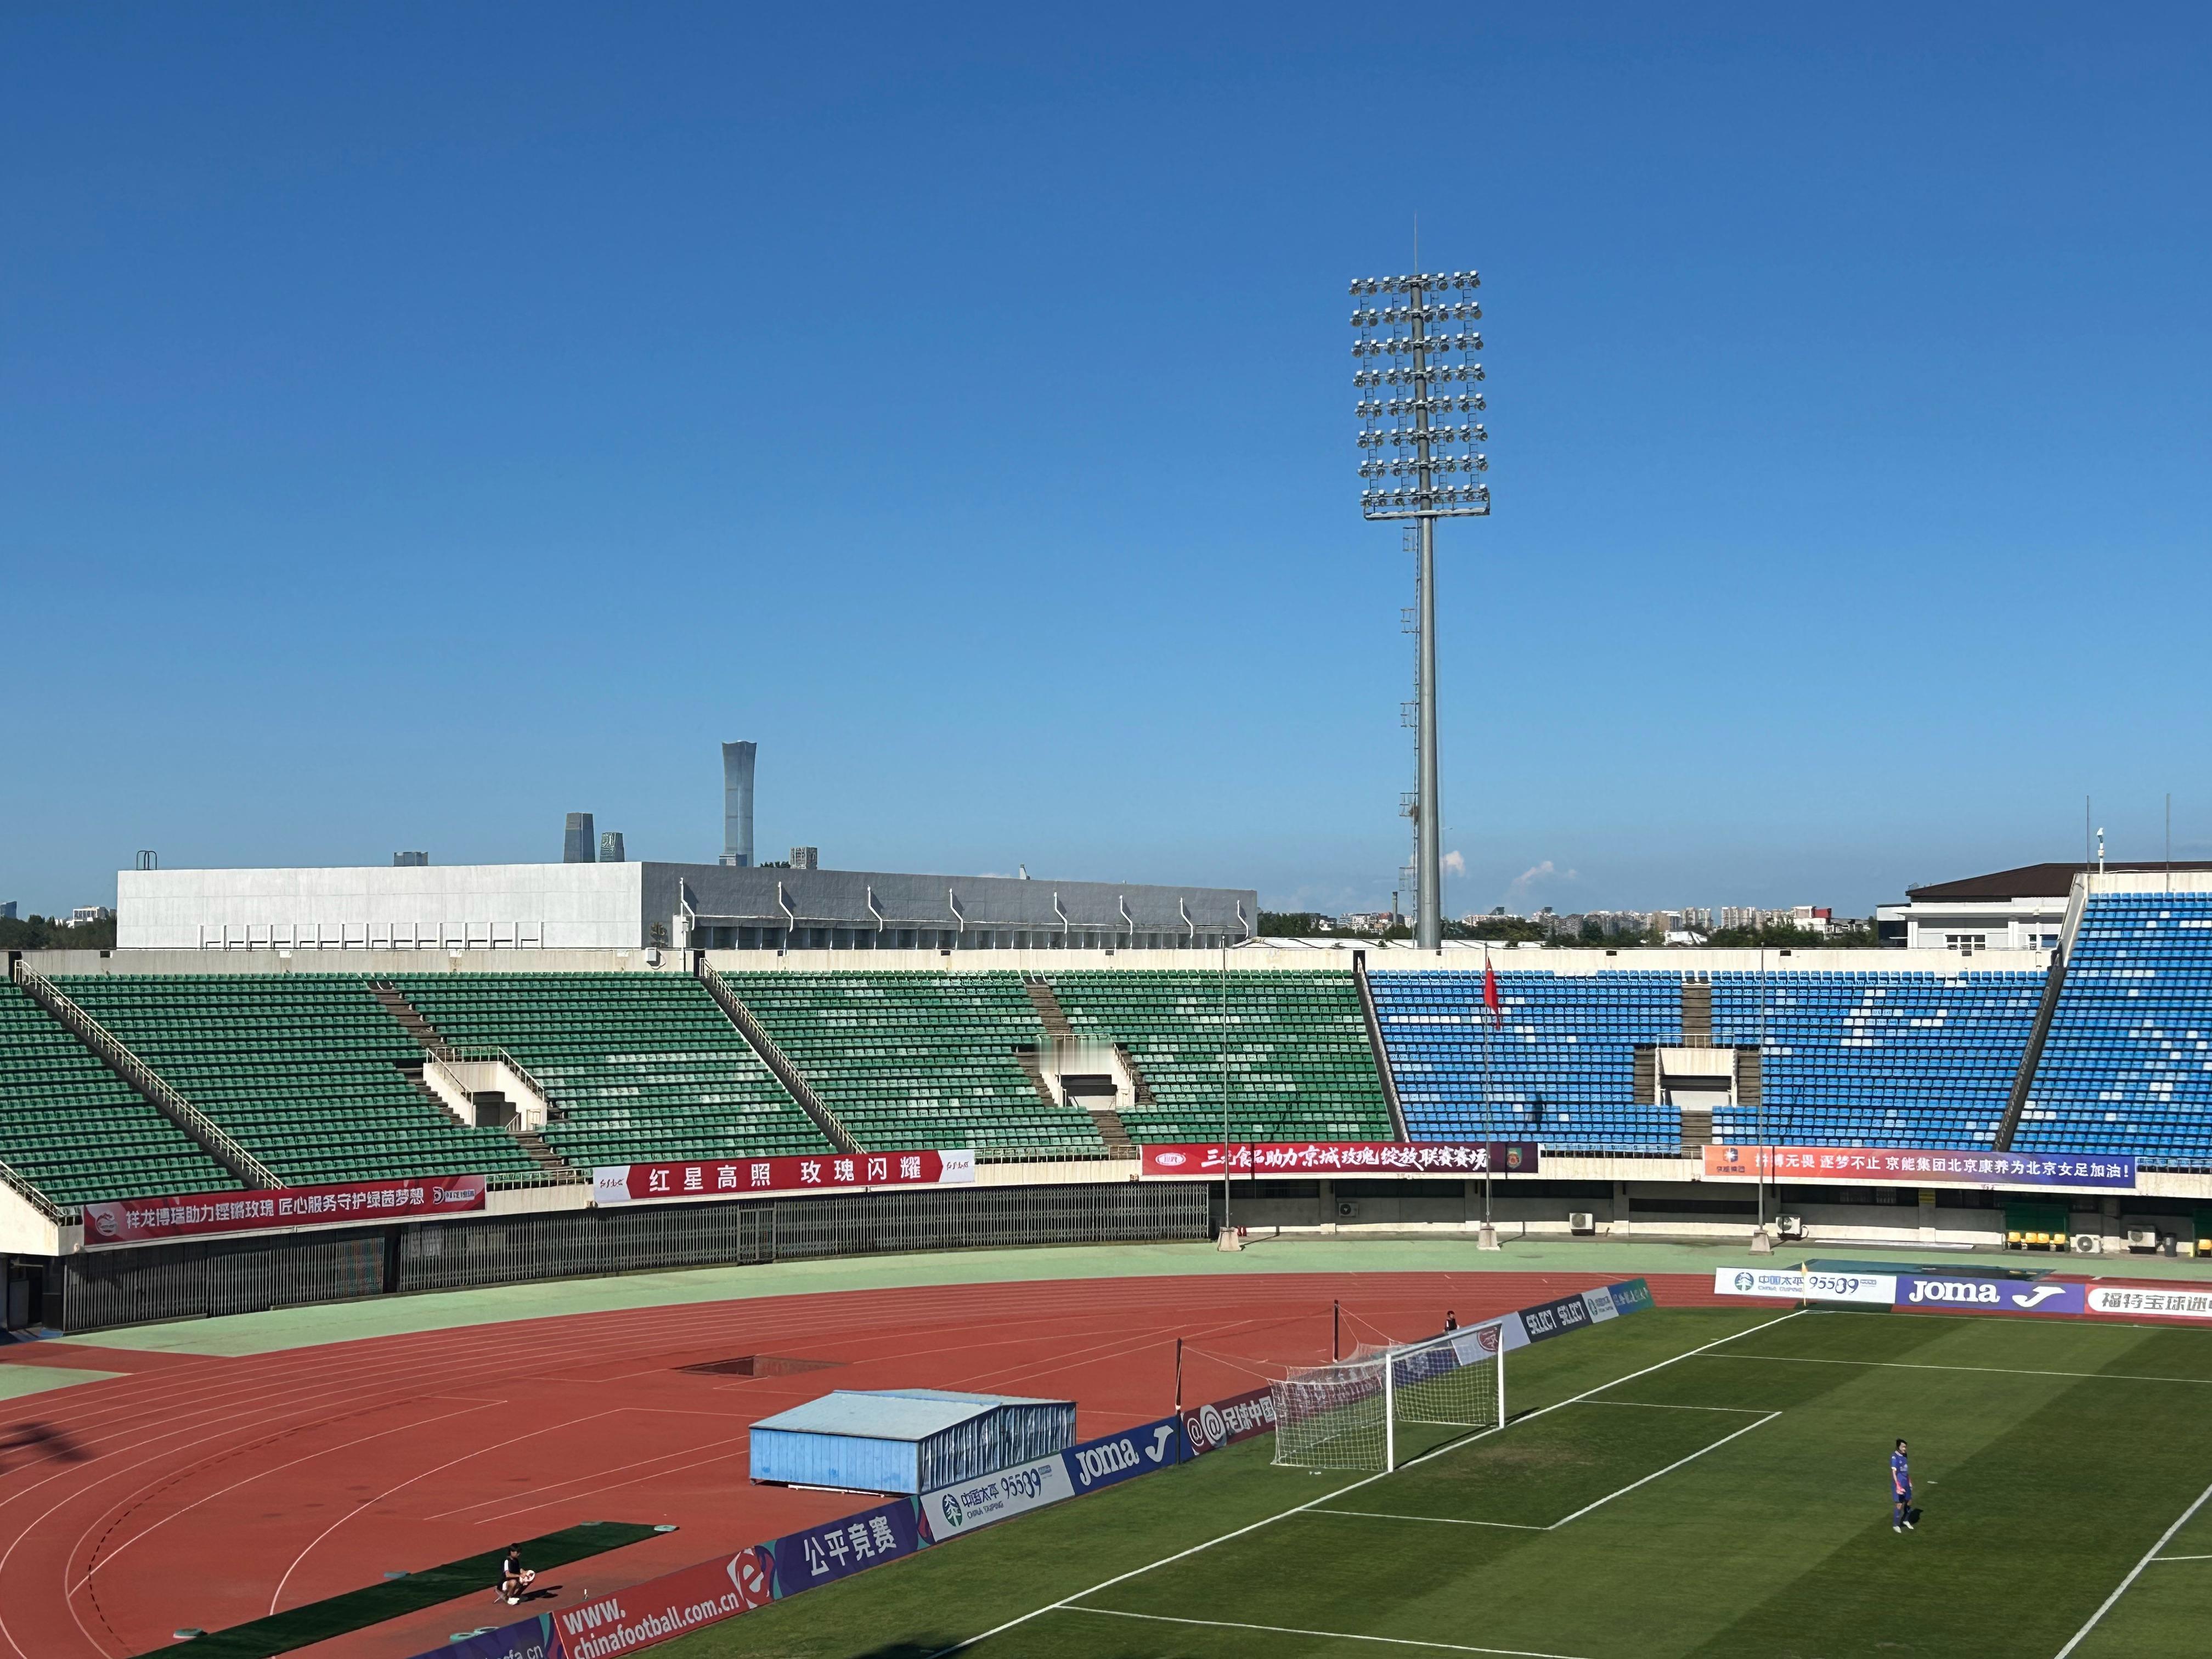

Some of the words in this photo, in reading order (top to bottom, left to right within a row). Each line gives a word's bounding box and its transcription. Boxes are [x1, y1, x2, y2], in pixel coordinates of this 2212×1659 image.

[650, 1163, 771, 1192] 红星高照
[800, 1156, 922, 1183] 玫瑰闪耀
[1809, 1276, 1859, 1295] 95589
[1526, 1310, 1556, 1334] SELECT
[1557, 1301, 1586, 1326] SELECT
[2102, 1293, 2212, 1312] 福特宝球迷
[1001, 1469, 1041, 1499] 95589
[804, 1516, 897, 1576] 公平竞赛
[574, 1592, 740, 1659] chinafootball.com.cn
